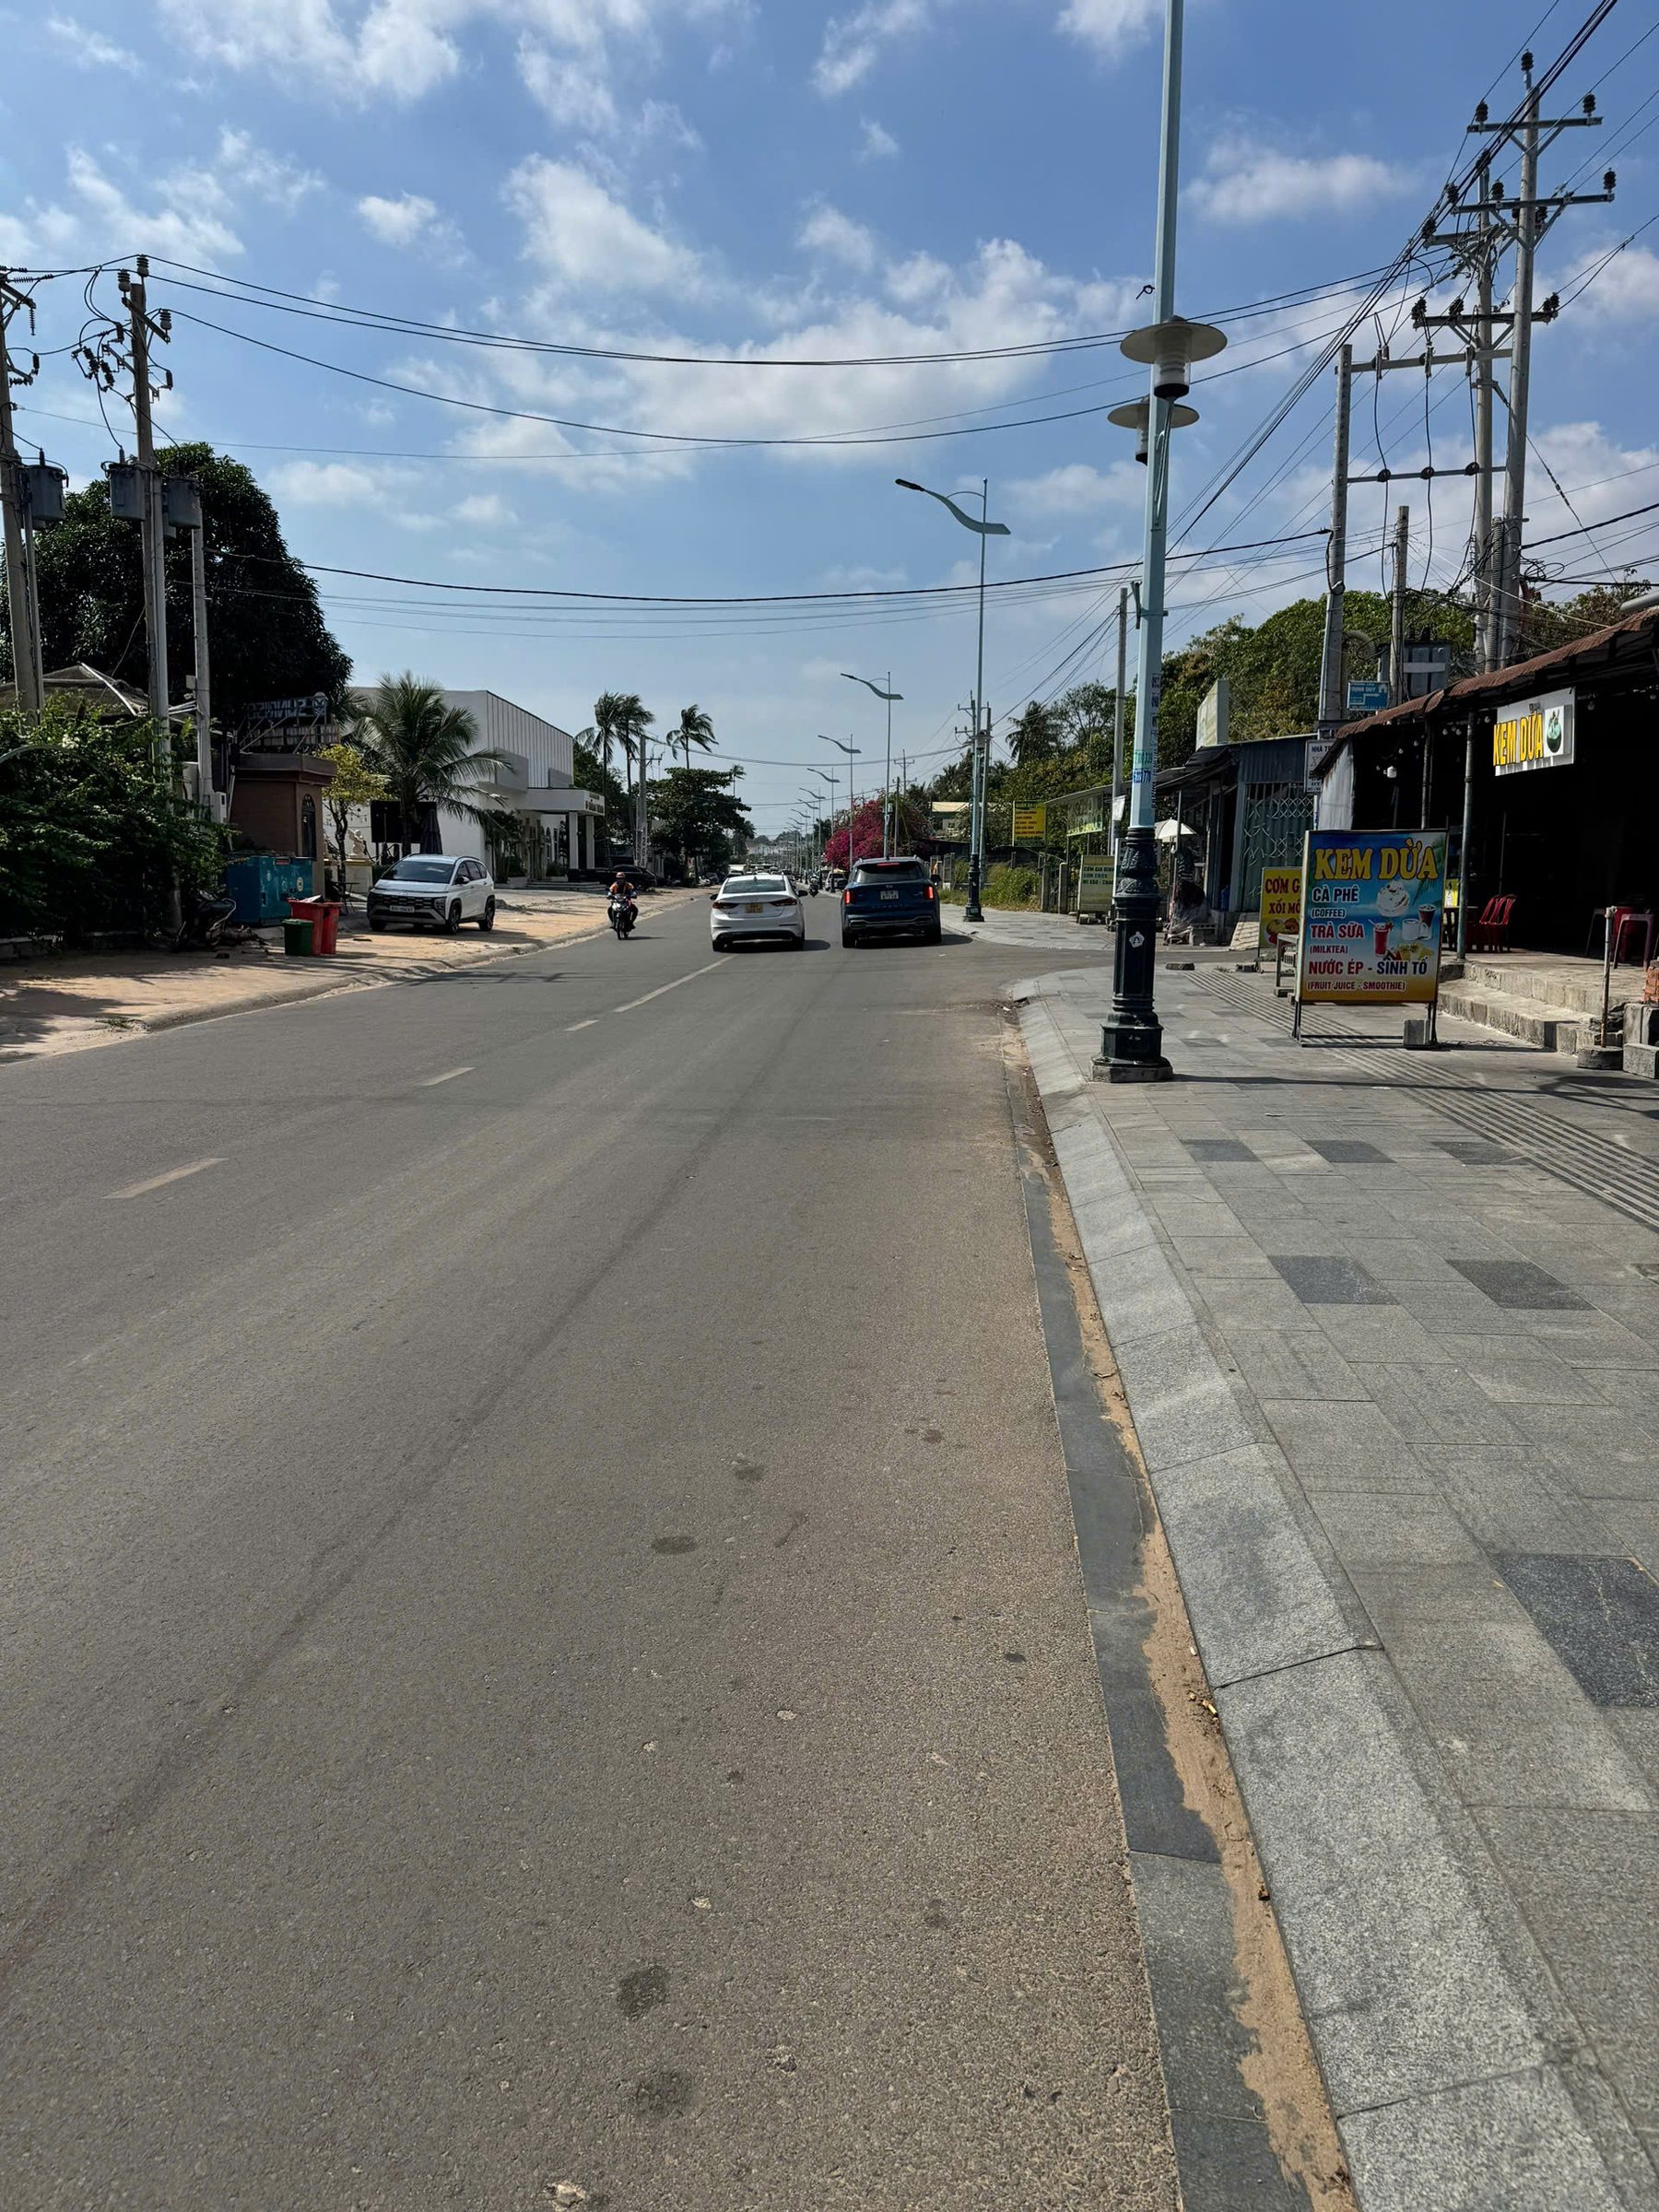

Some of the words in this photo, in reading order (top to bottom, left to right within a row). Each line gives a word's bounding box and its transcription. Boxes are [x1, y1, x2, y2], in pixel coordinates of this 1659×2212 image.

[1493, 719, 1517, 766] KEM
[1314, 848, 1373, 880] KEM
[1378, 837, 1439, 880] DỪA
[1265, 876, 1288, 894] CƠM
[1292, 878, 1301, 894] G
[1312, 885, 1330, 902] CÀ
[1334, 885, 1359, 902] PHÊ
[1268, 898, 1286, 914] XỐI
[1312, 909, 1346, 918] (COFFEE)
[1311, 922, 1335, 938] TRÀ
[1338, 922, 1364, 938] SỮA
[1310, 945, 1348, 954] (MILKTEA)
[1309, 959, 1344, 974] NƯỚC
[1347, 959, 1364, 974] ÉP
[1376, 961, 1408, 974] SINH
[1412, 956, 1428, 974] TỐ
[1308, 981, 1332, 990] (FRUIT
[1334, 981, 1356, 990] JUICE
[1363, 981, 1406, 991] SMOOTHIE)
